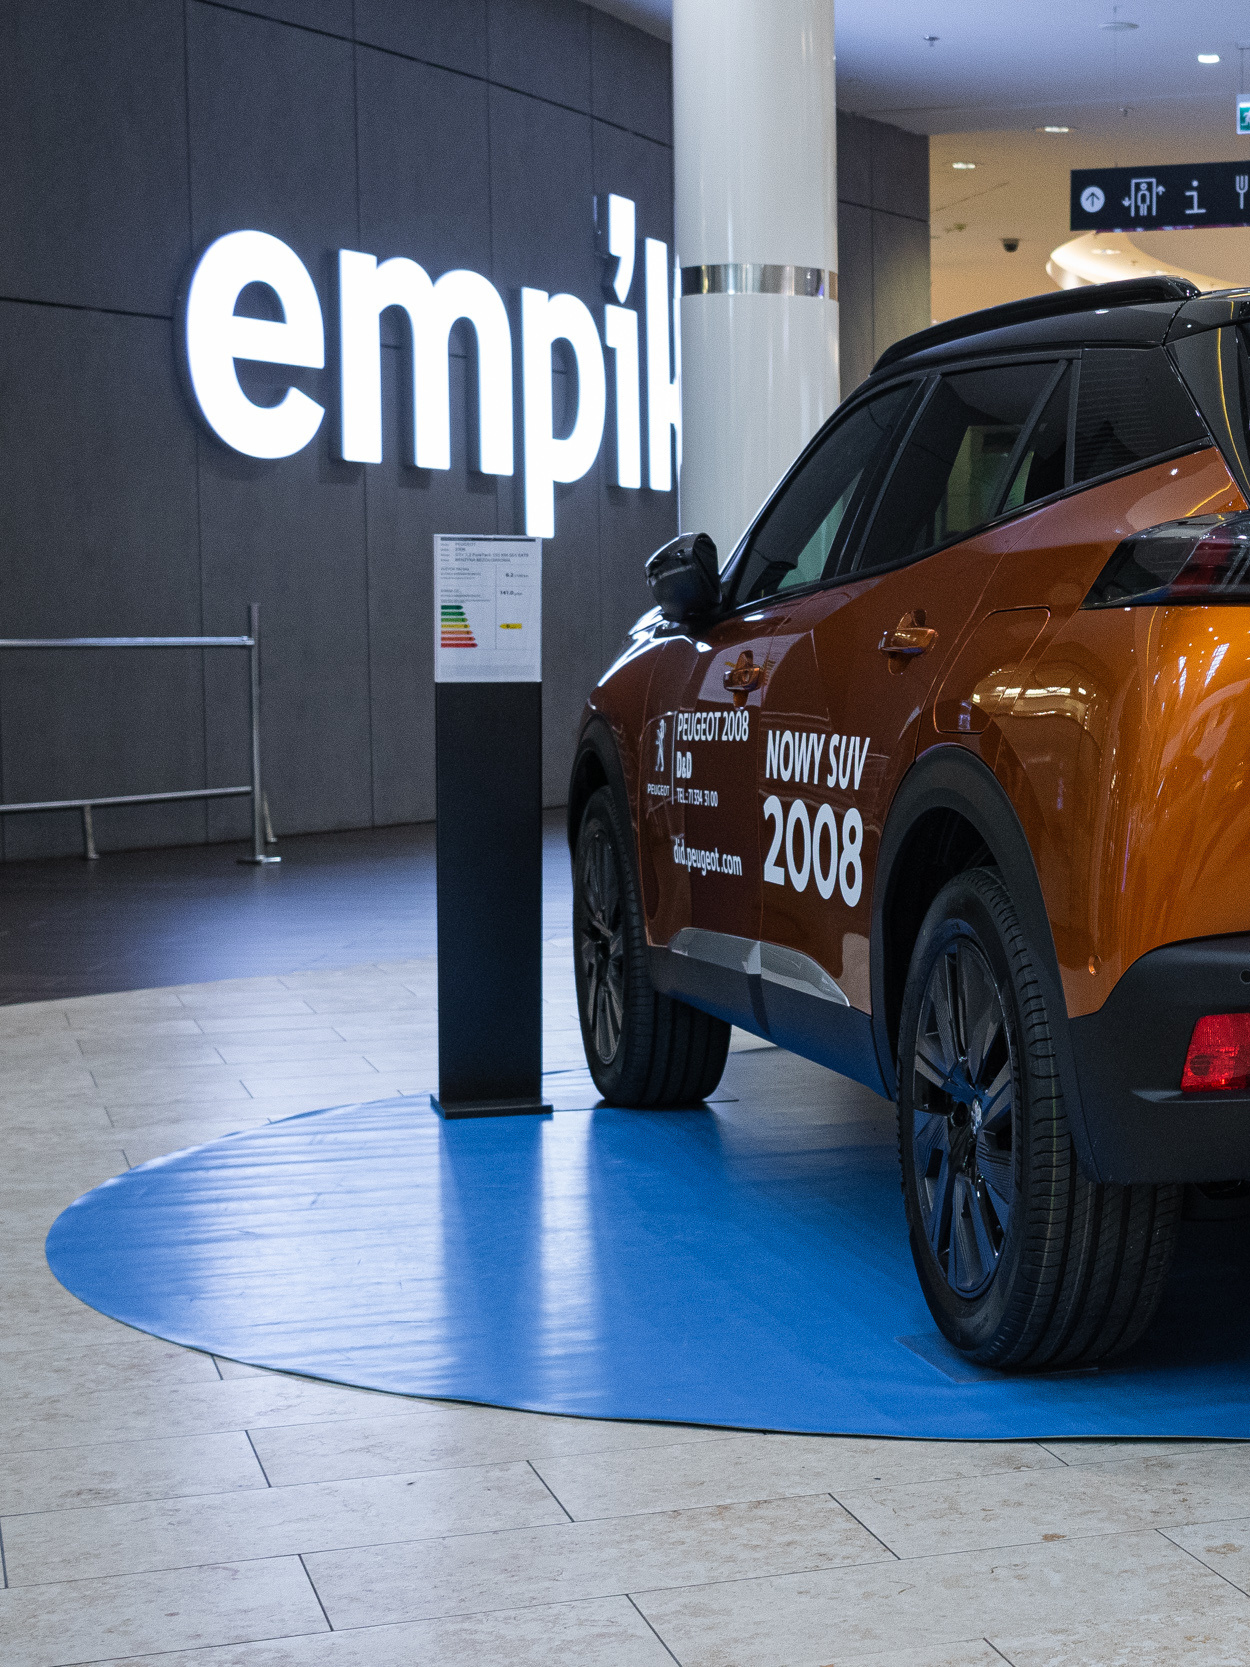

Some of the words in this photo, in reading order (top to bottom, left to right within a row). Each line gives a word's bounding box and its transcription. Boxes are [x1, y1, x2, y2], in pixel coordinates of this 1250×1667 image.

[677, 711, 721, 741] PEUGEOT
[721, 710, 749, 741] 2008
[676, 751, 692, 778] D&D
[765, 730, 826, 785] NOWY
[827, 733, 871, 790] SUV
[647, 783, 670, 797] PEUGEOT
[674, 838, 743, 876] did.peugeot.com
[763, 795, 864, 908] 2008
